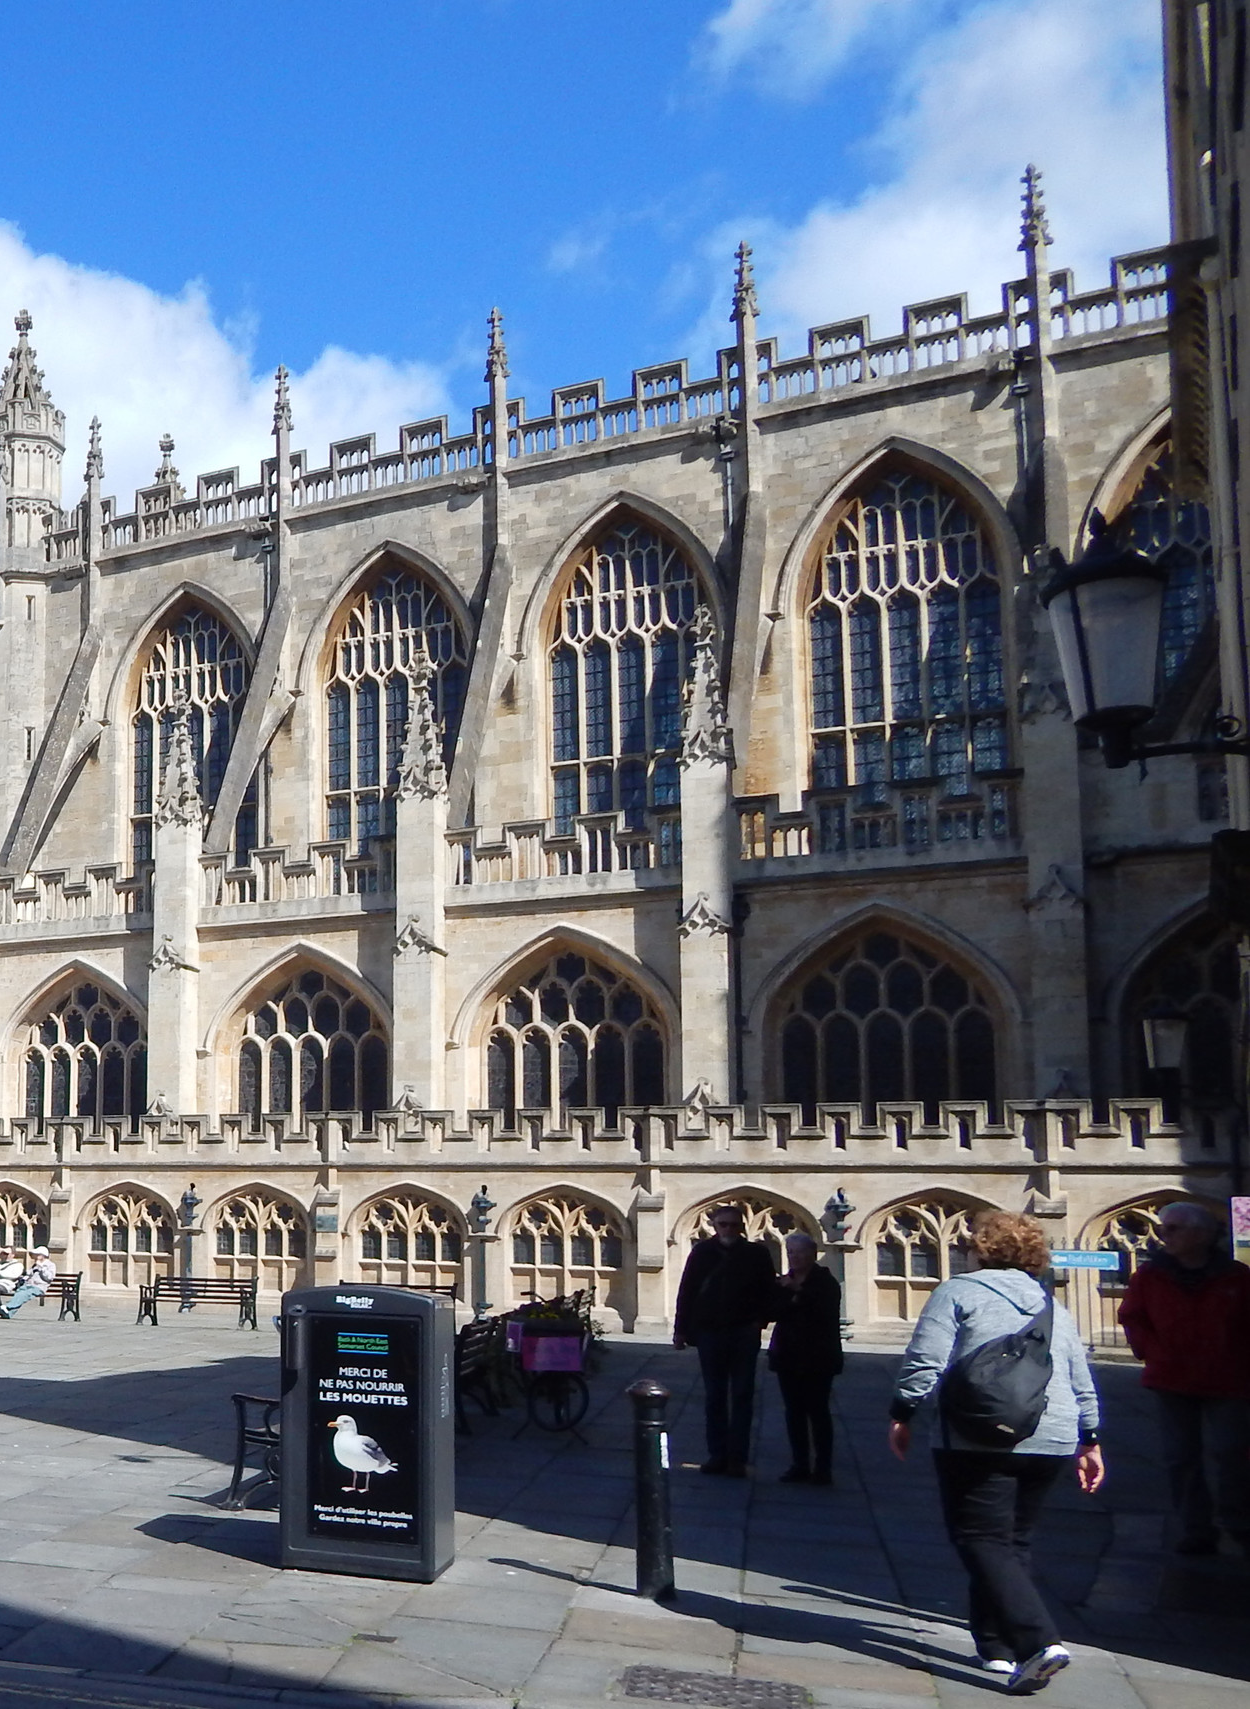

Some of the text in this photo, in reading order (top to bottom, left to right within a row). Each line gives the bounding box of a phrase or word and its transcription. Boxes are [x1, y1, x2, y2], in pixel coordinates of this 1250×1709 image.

[336, 1295, 374, 1305] BigBelly
[339, 1367, 388, 1378] MERCI DE
[319, 1378, 404, 1392] NE PAS NOURRIR
[319, 1391, 408, 1406] LES MOUETTES
[314, 1504, 334, 1512] Merci
[335, 1506, 366, 1515] d'utiliser
[379, 1511, 413, 1519] poubelles
[319, 1513, 344, 1522] Gardez
